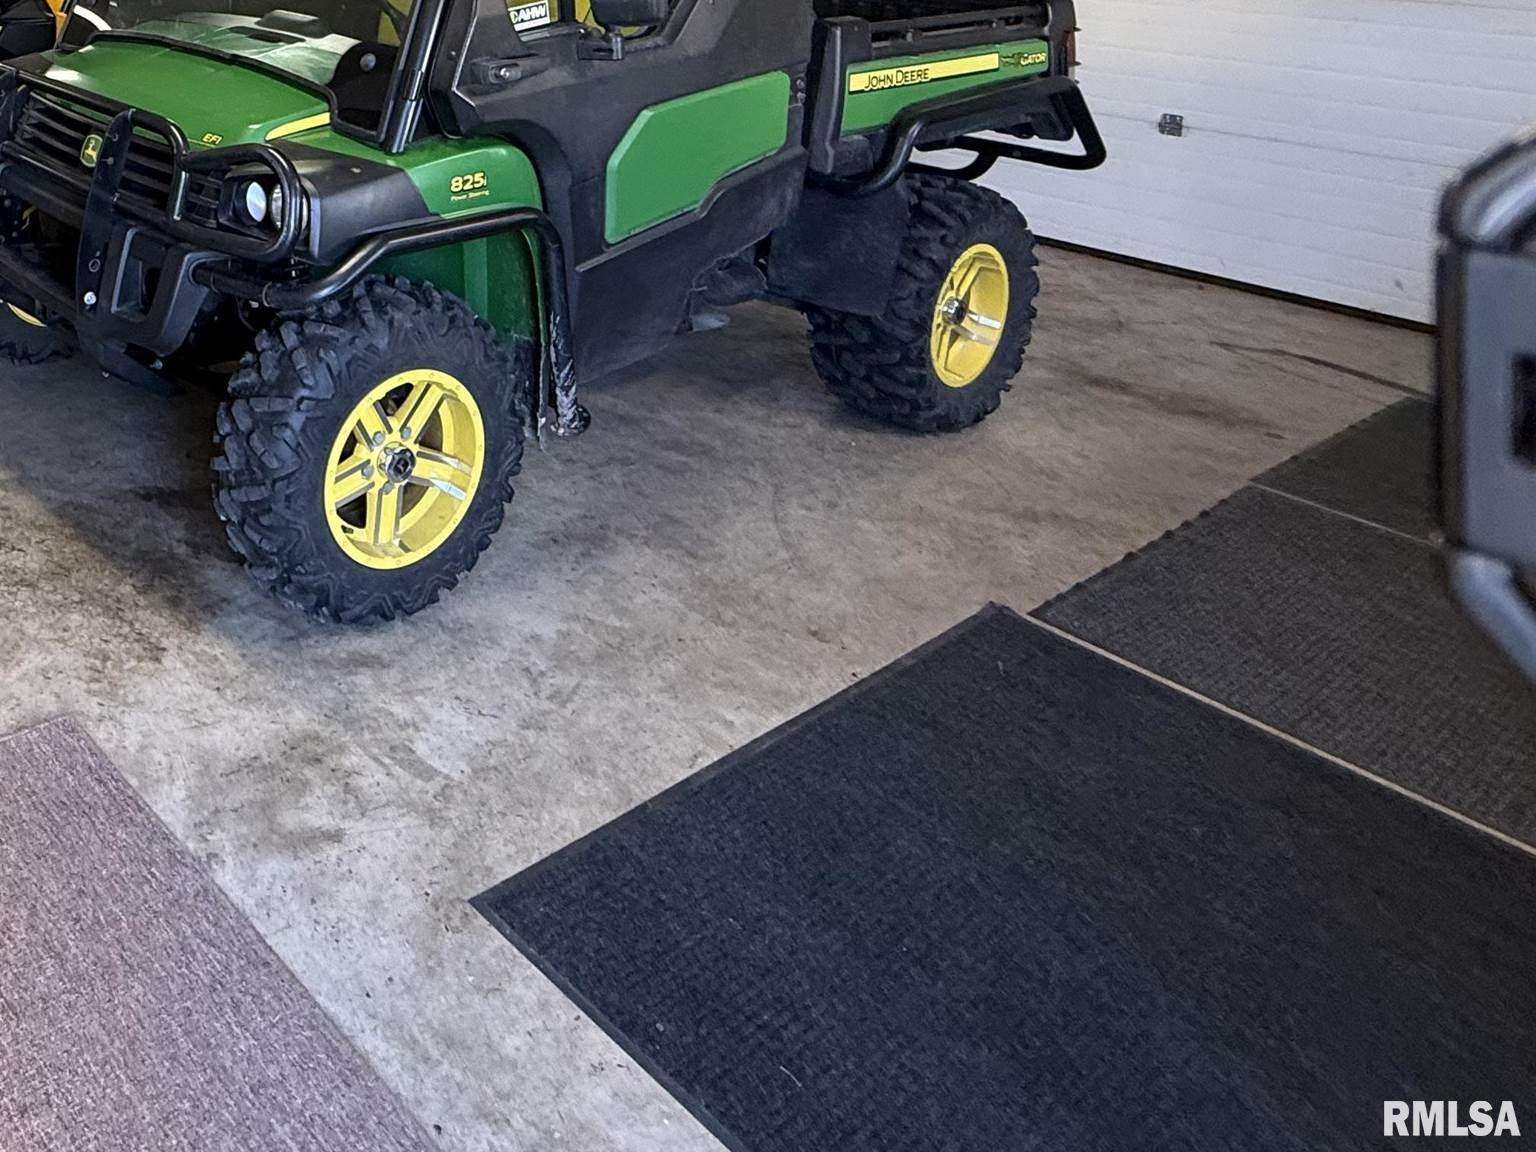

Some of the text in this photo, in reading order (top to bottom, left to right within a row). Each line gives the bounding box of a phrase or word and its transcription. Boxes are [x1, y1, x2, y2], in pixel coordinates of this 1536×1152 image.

[1020, 52, 1046, 65] GATOR
[864, 67, 930, 90] JOHN DEERE
